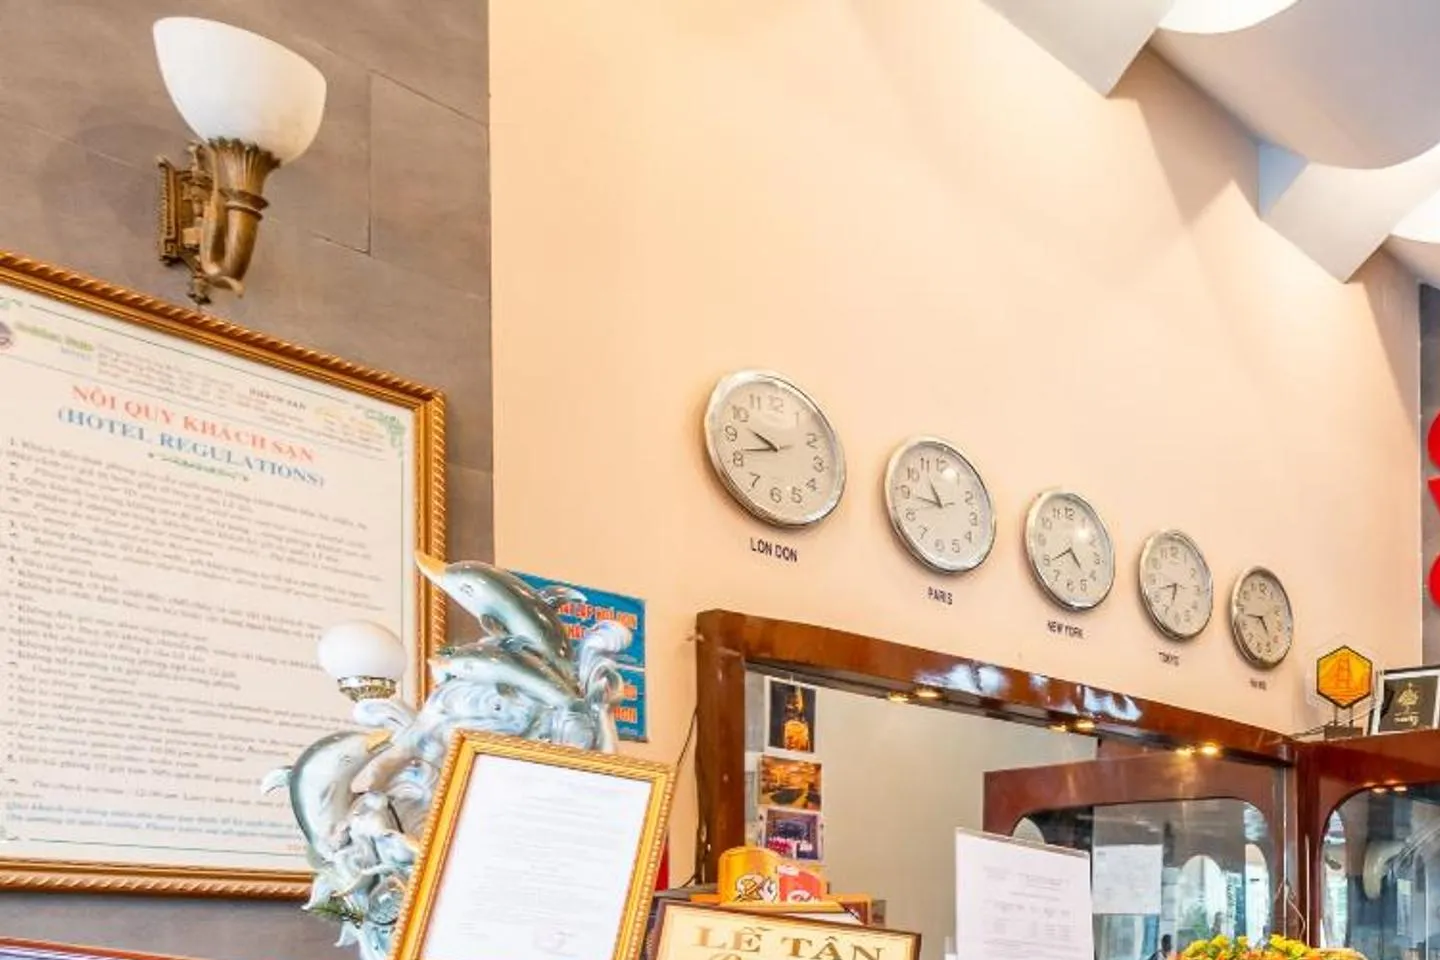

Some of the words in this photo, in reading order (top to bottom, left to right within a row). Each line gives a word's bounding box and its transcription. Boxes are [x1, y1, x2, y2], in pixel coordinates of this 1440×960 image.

[749, 393, 761, 411] 11
[732, 405, 750, 423] 10
[724, 425, 738, 442] 9
[806, 432, 818, 449] 2
[732, 450, 744, 468] 8
[813, 455, 825, 473] 3
[749, 471, 761, 488] 7
[805, 478, 817, 492] 4
[769, 486, 782, 503] 6
[791, 486, 803, 503] 5
[926, 586, 953, 605] PARIS
